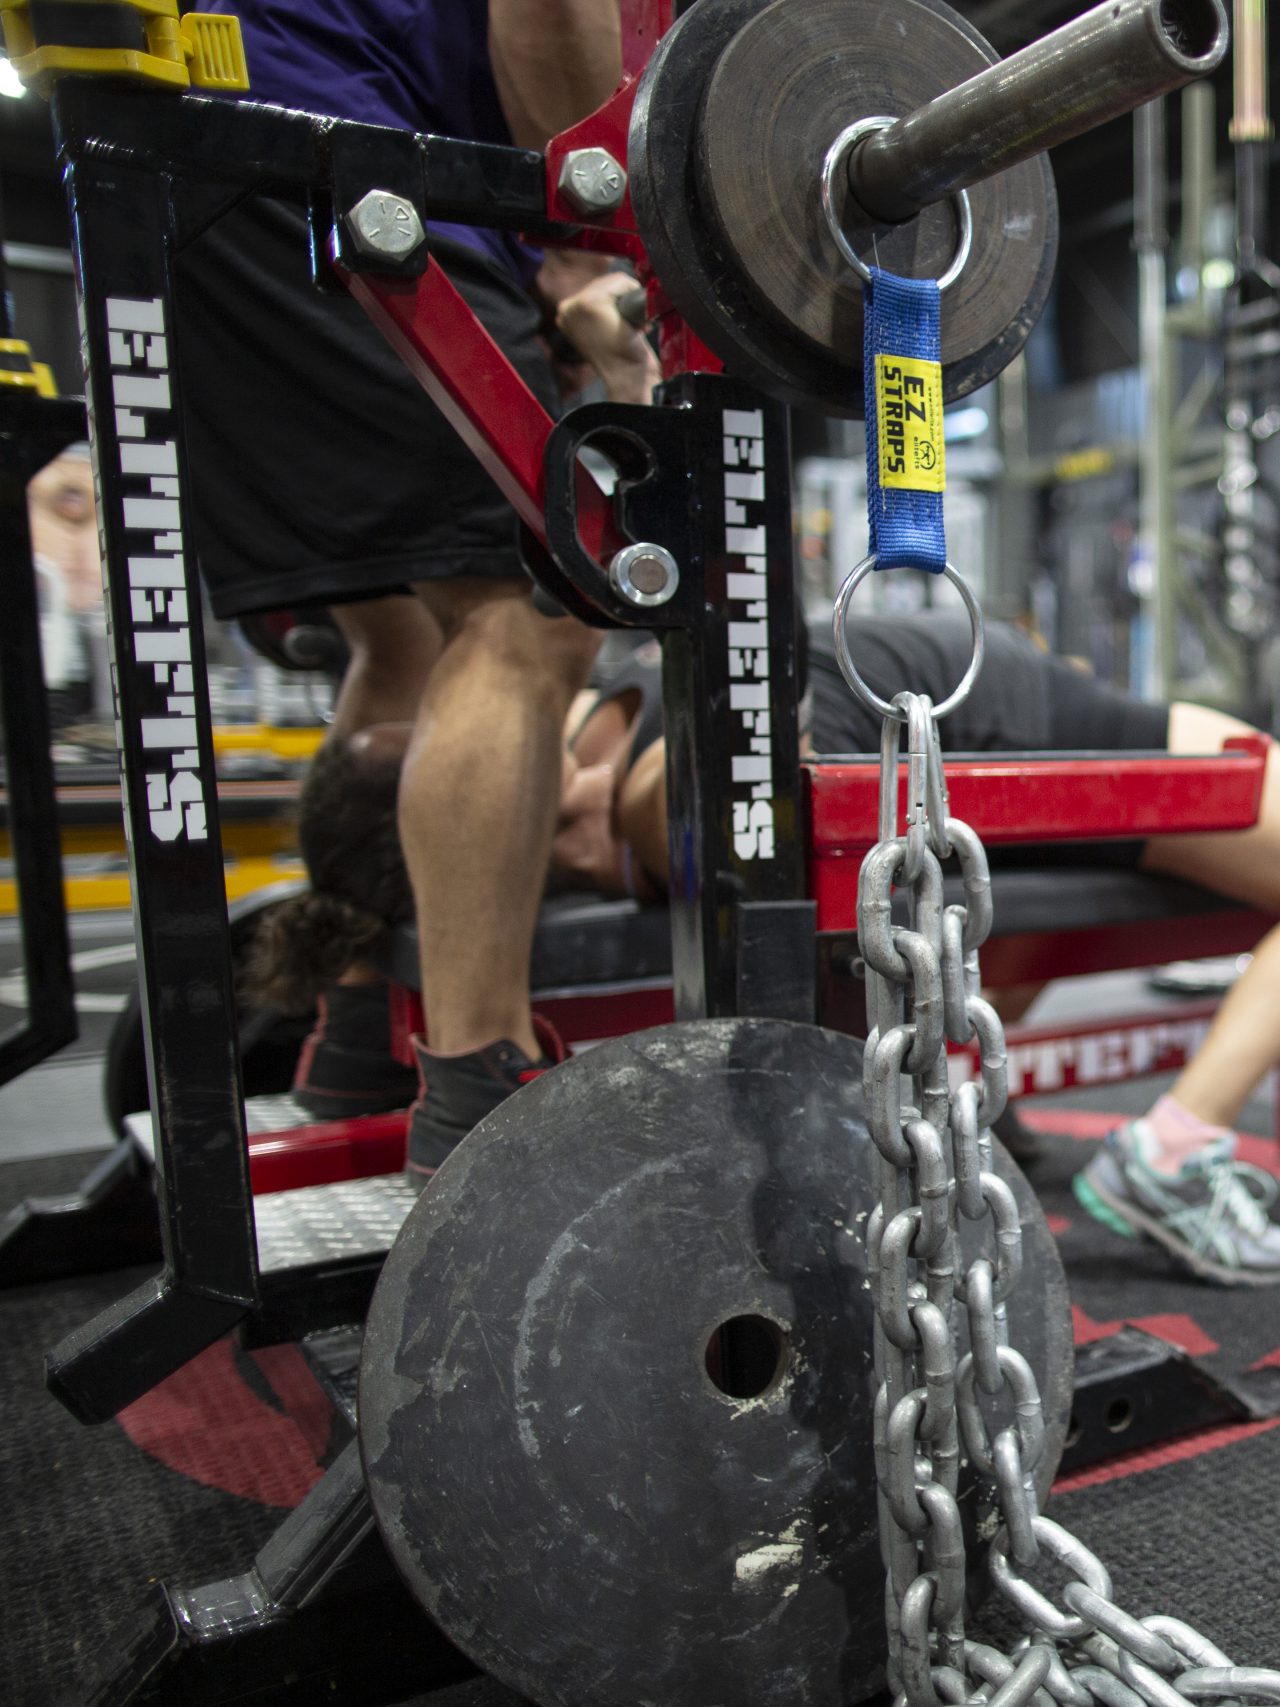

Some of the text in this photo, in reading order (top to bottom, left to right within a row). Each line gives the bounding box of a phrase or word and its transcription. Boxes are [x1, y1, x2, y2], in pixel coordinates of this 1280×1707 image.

[885, 365, 905, 473] STRAPS
[905, 376, 926, 421] EZ
[106, 297, 208, 844] ELITEFTS
[723, 408, 774, 860] ELITEFTS
